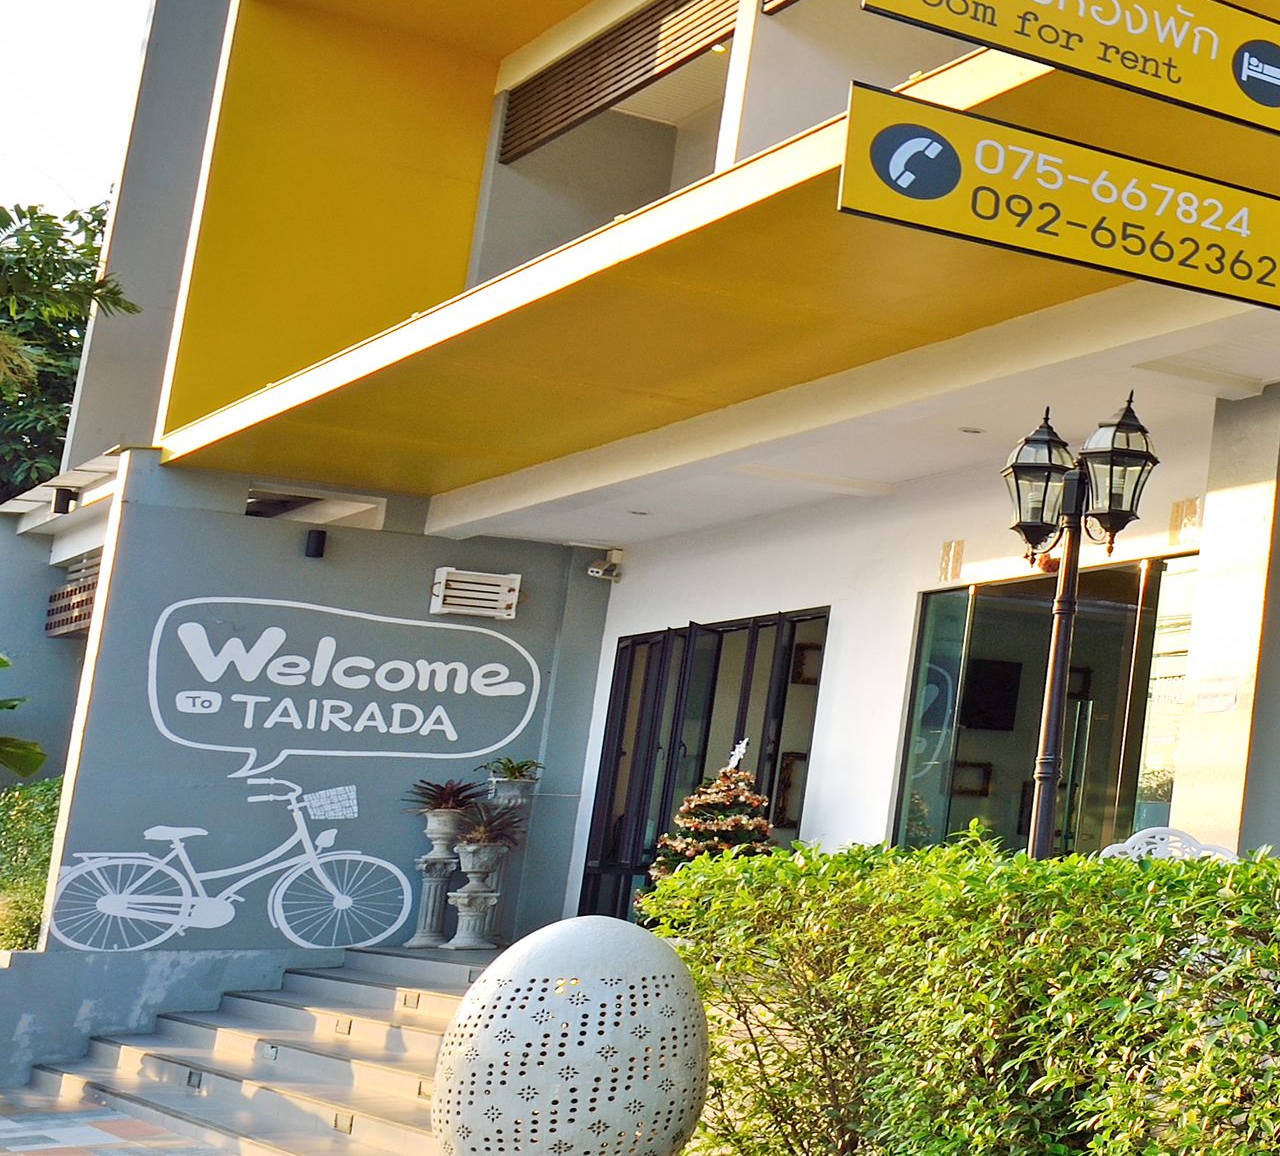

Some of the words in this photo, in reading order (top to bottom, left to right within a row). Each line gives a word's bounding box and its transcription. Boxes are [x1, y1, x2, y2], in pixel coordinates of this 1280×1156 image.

[1013, 10, 1084, 52] for
[1097, 39, 1182, 84] rent
[974, 138, 1251, 238] 075-667824
[971, 185, 1278, 287] 092-6562362
[177, 622, 526, 696] Welcome
[185, 695, 212, 709] To
[231, 693, 458, 741] TAIRADA
